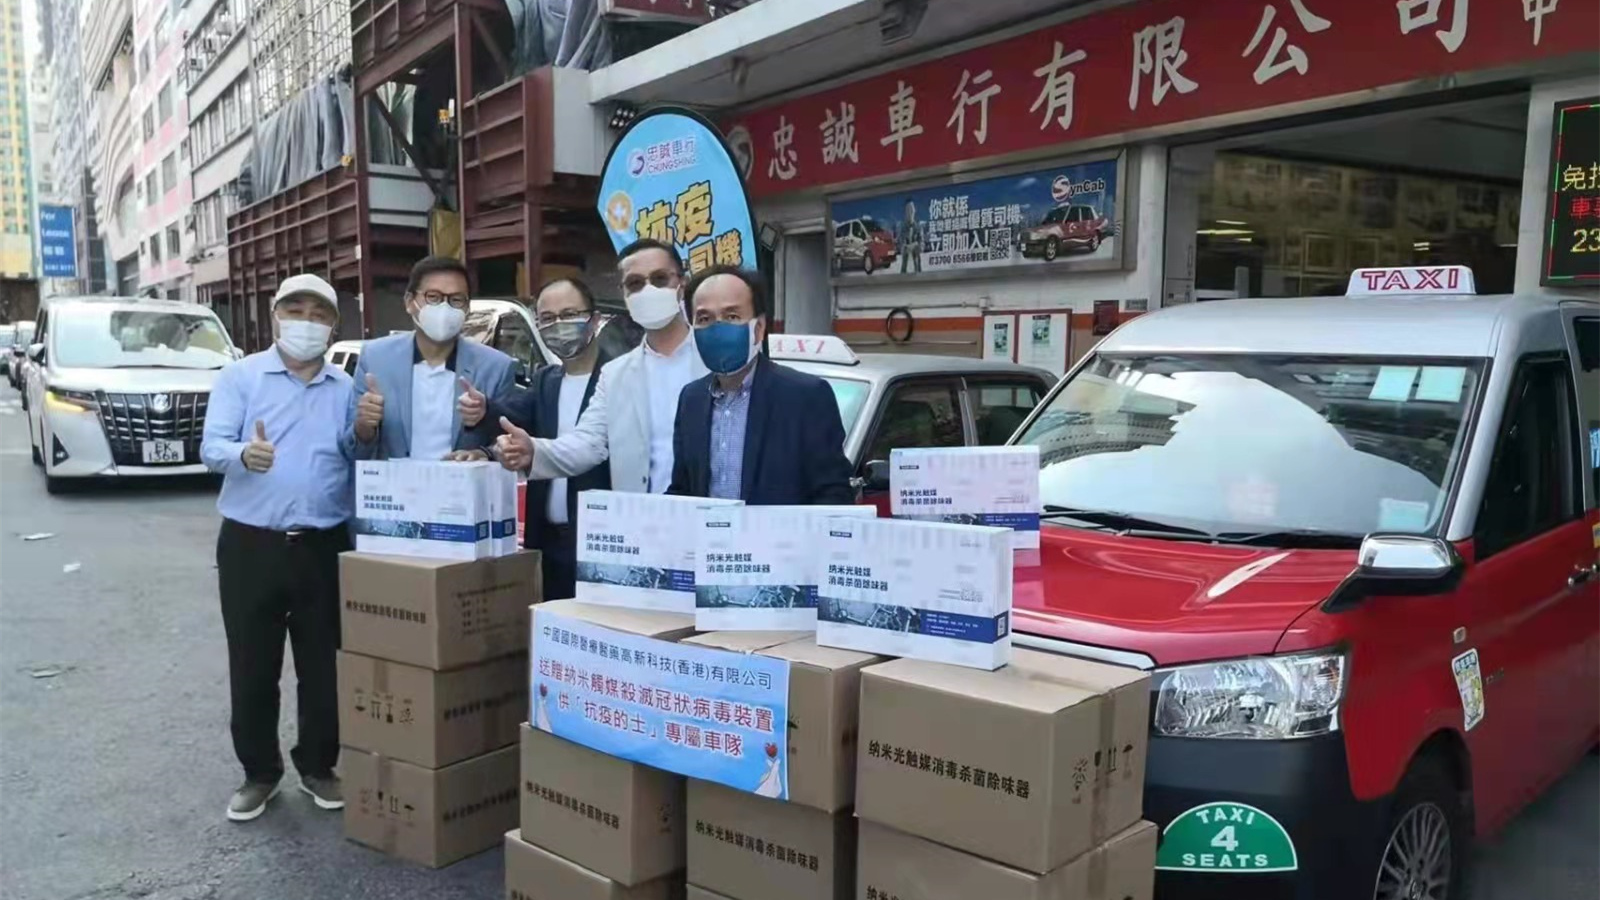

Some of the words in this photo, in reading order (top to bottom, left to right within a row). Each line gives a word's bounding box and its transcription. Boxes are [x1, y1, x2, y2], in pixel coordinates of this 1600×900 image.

[635, 180, 714, 248] 抗疫
[929, 195, 969, 220] 你就係
[1361, 268, 1459, 290] TAXI
[706, 552, 752, 563] 纳米光触媒
[828, 564, 872, 578] 纳米光触媒
[868, 740, 1031, 799] 纳米光触媒消毒杀菌除味器
[1196, 807, 1255, 825] TAXI
[1210, 825, 1239, 852] 4
[1182, 853, 1269, 868] SEATS
